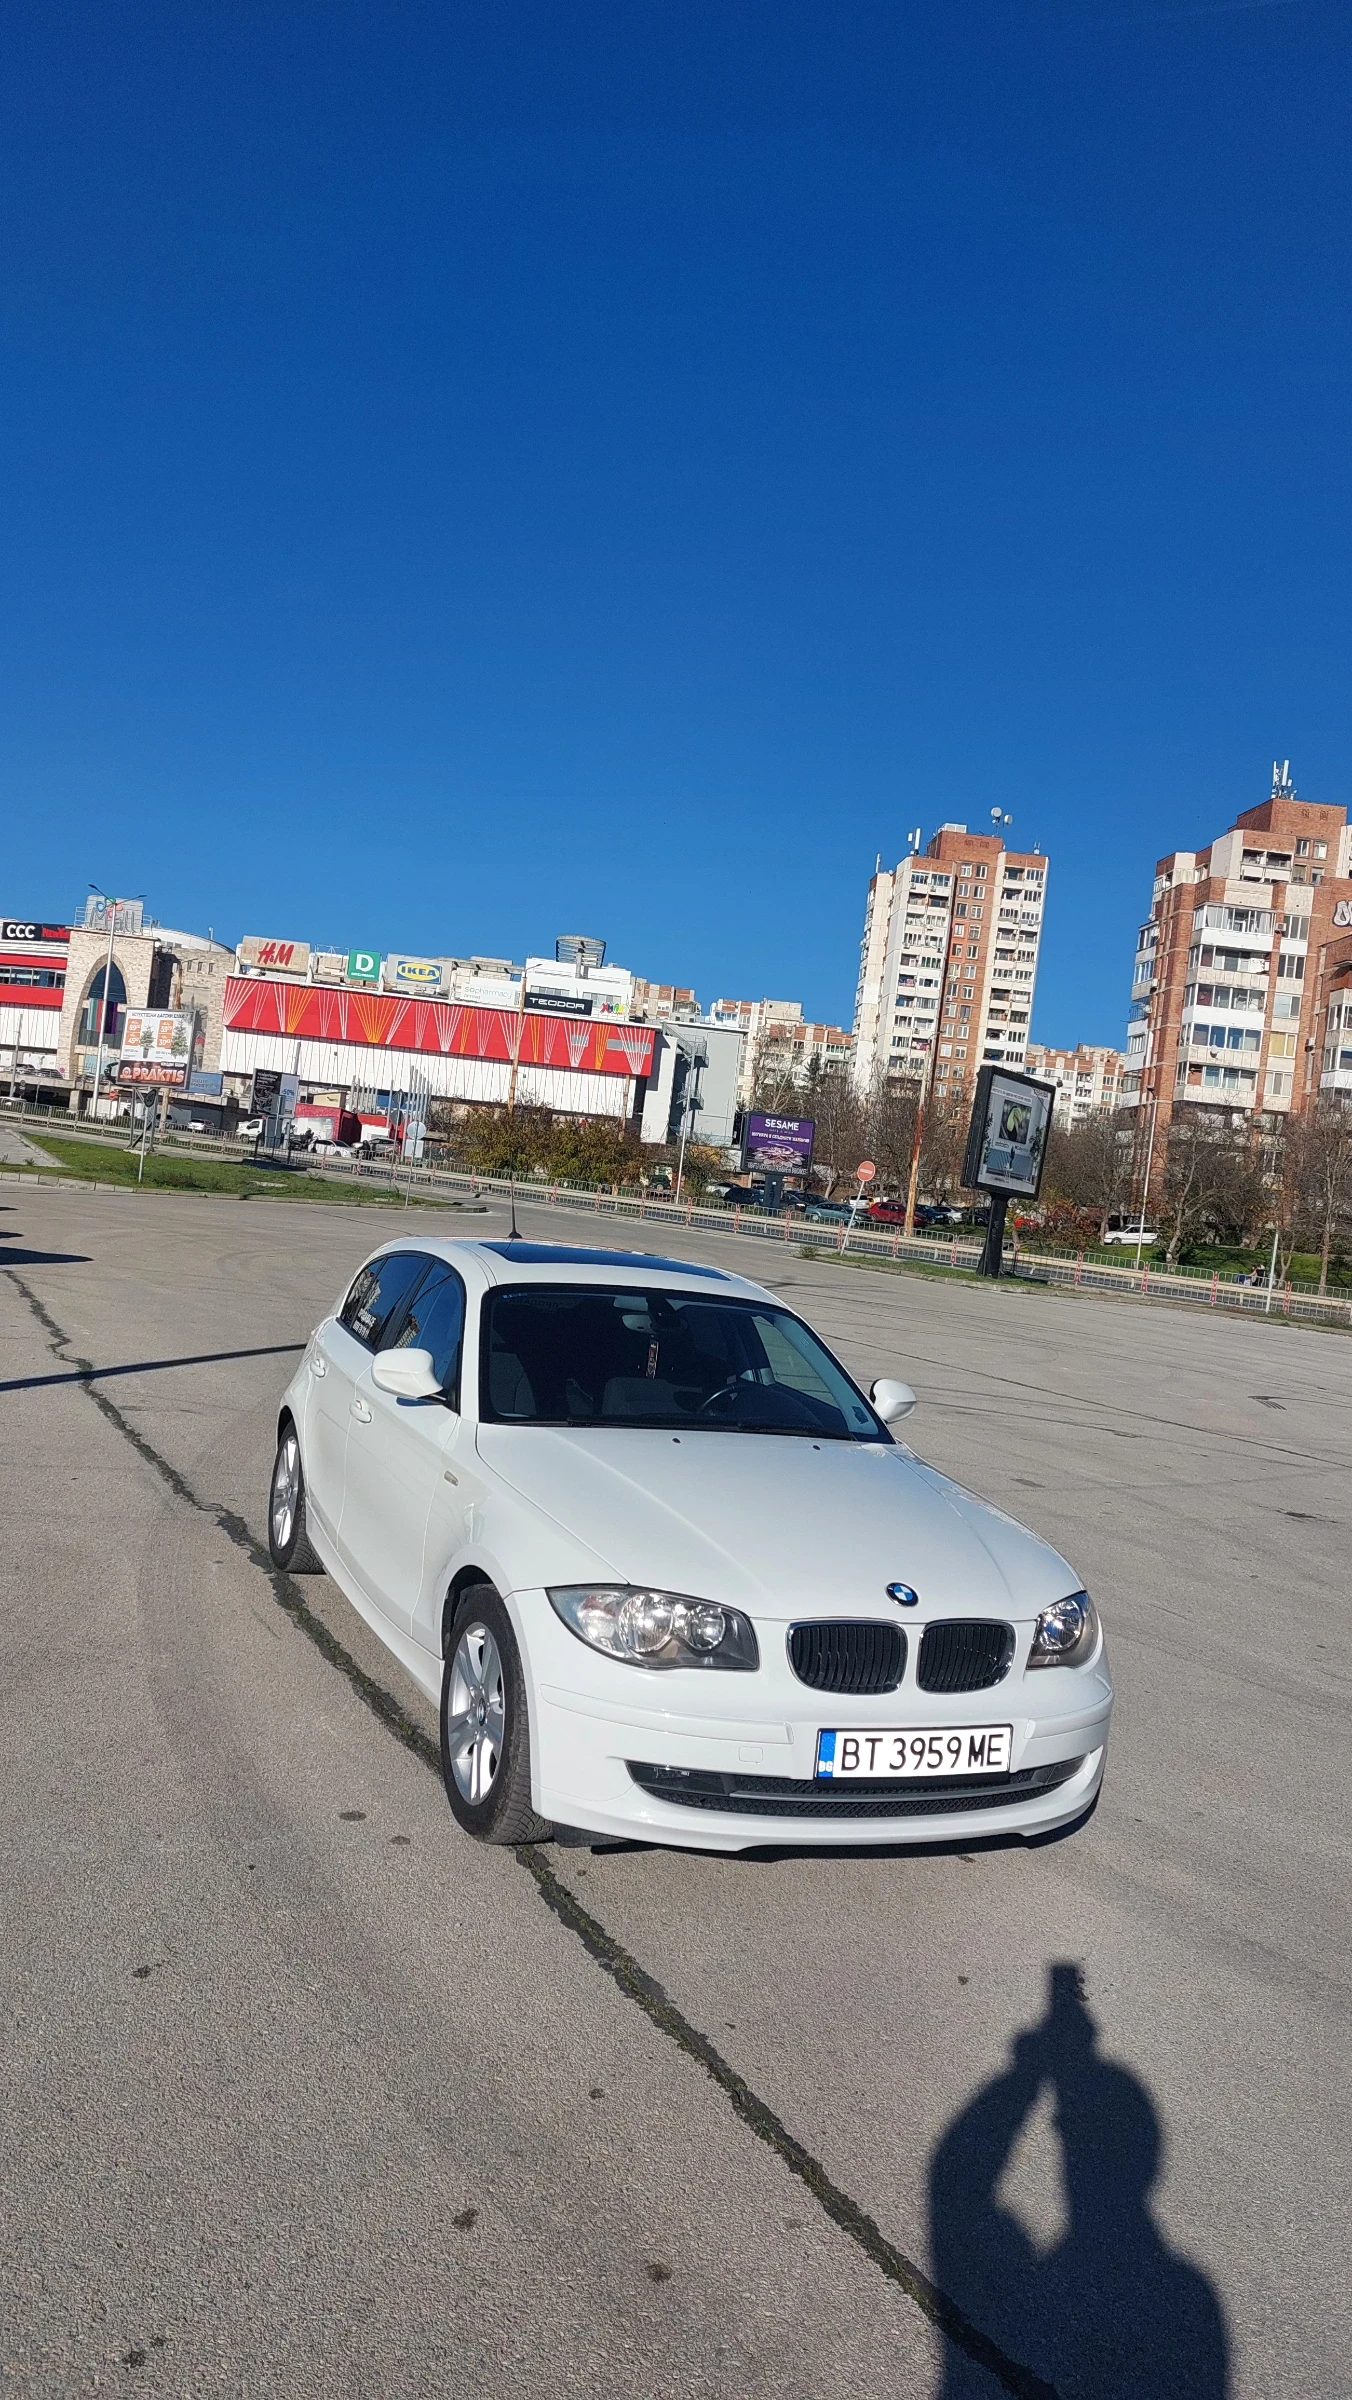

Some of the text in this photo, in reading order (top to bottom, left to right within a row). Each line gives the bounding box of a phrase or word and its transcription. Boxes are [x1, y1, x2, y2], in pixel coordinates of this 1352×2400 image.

[6, 924, 36, 939] CCC
[257, 941, 295, 967] H&M
[355, 953, 374, 972] D
[401, 966, 437, 978] IKEA
[464, 986, 513, 999] sopharmacy
[529, 997, 586, 1010] TEODOR
[132, 1067, 185, 1084] PRAKTIS
[764, 1118, 800, 1131] SESAME
[841, 1733, 1005, 1772] BT 3959 ME
[818, 1760, 834, 1772] BG
